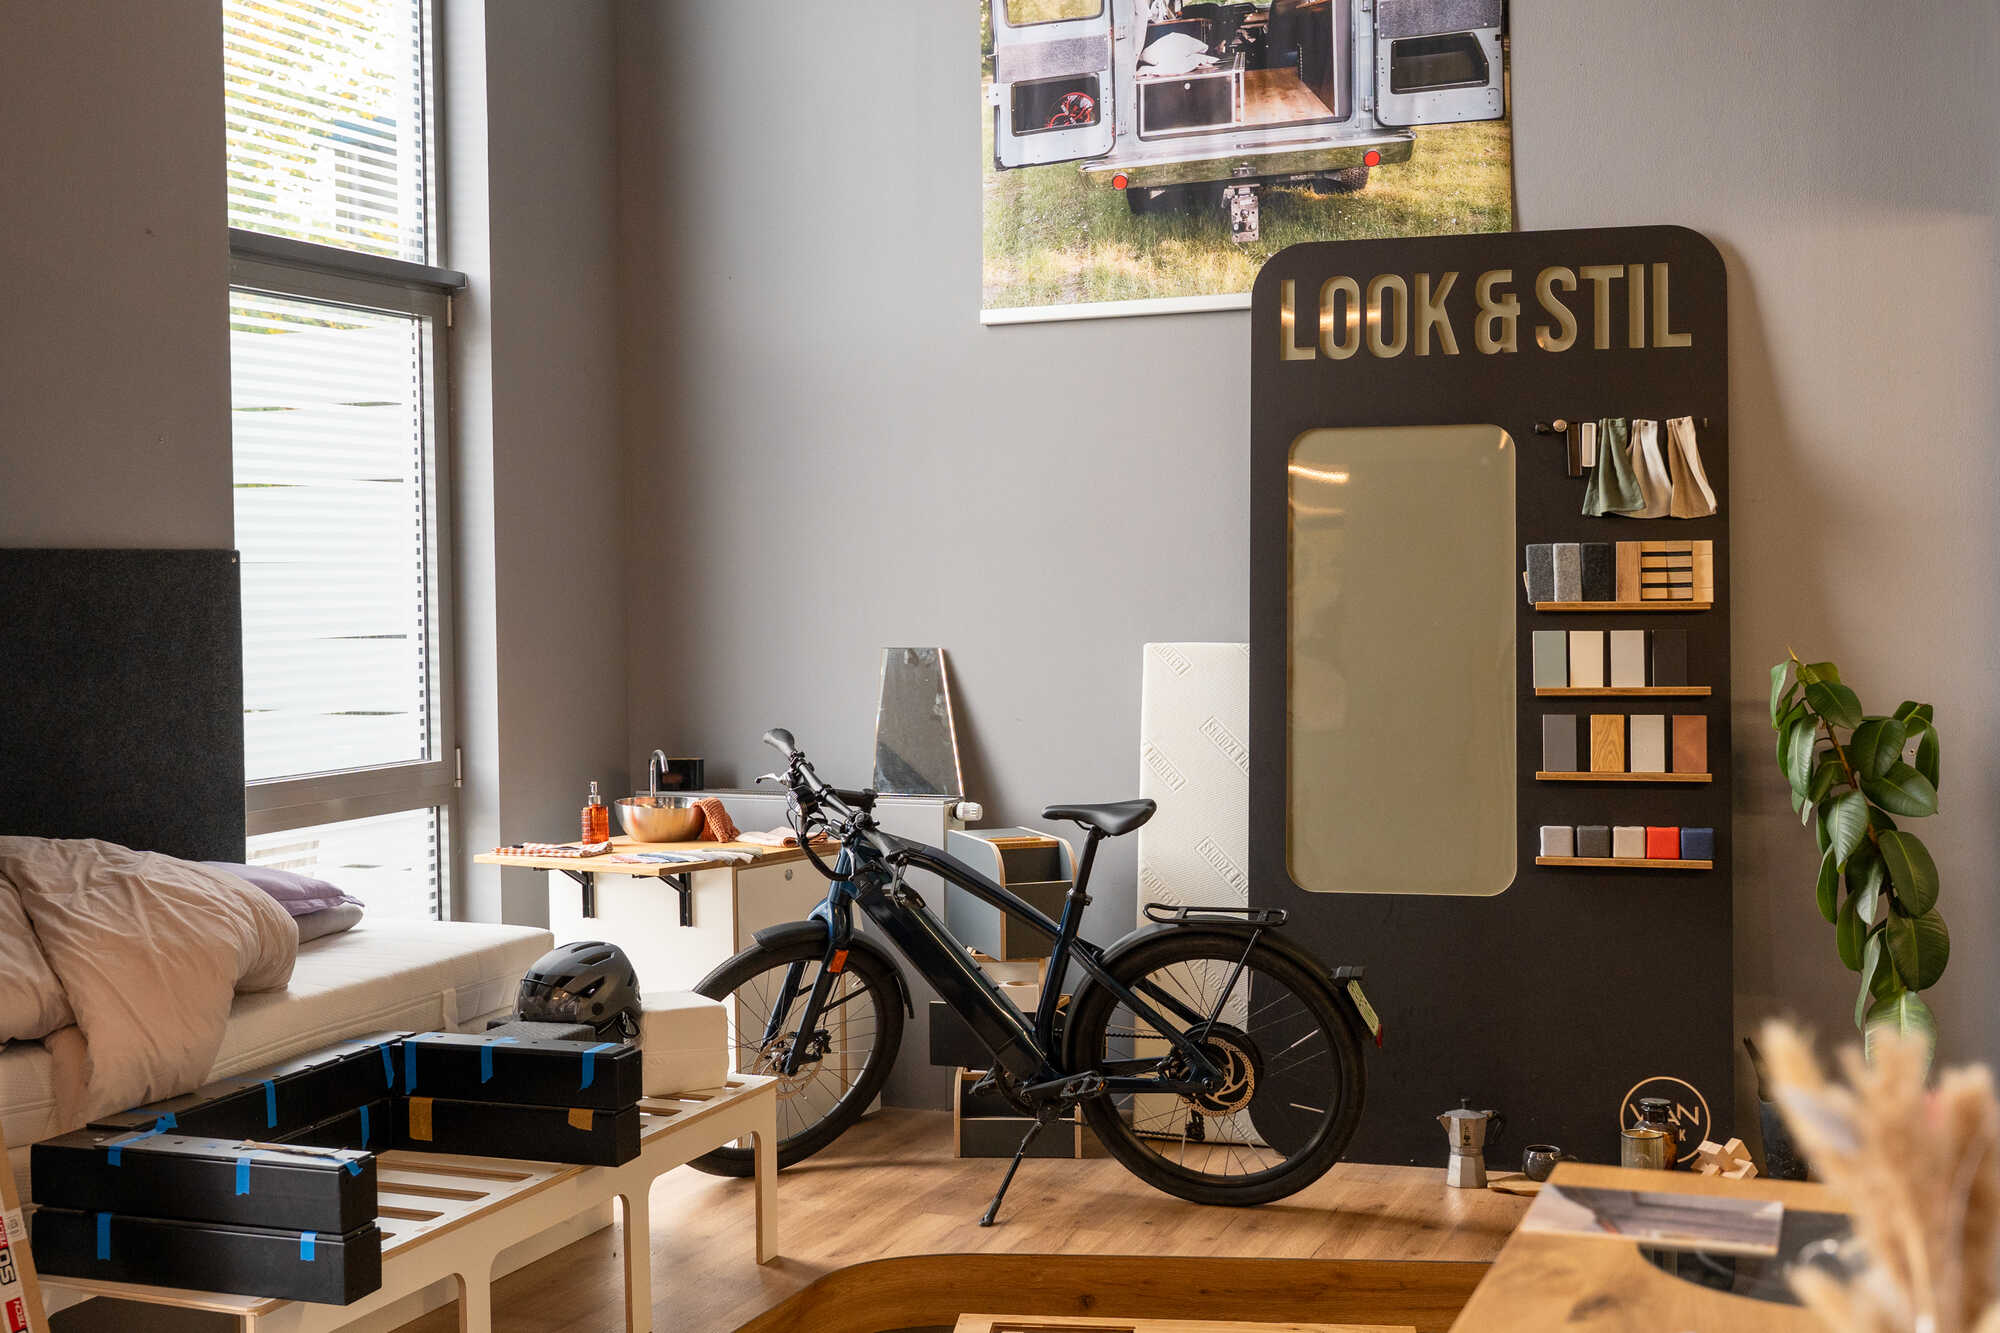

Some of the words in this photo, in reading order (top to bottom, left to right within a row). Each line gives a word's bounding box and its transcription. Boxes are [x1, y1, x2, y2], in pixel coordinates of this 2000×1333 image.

[1280, 271, 1460, 361] LOOK
[1474, 269, 1521, 355] &
[1535, 262, 1692, 353] STIL
